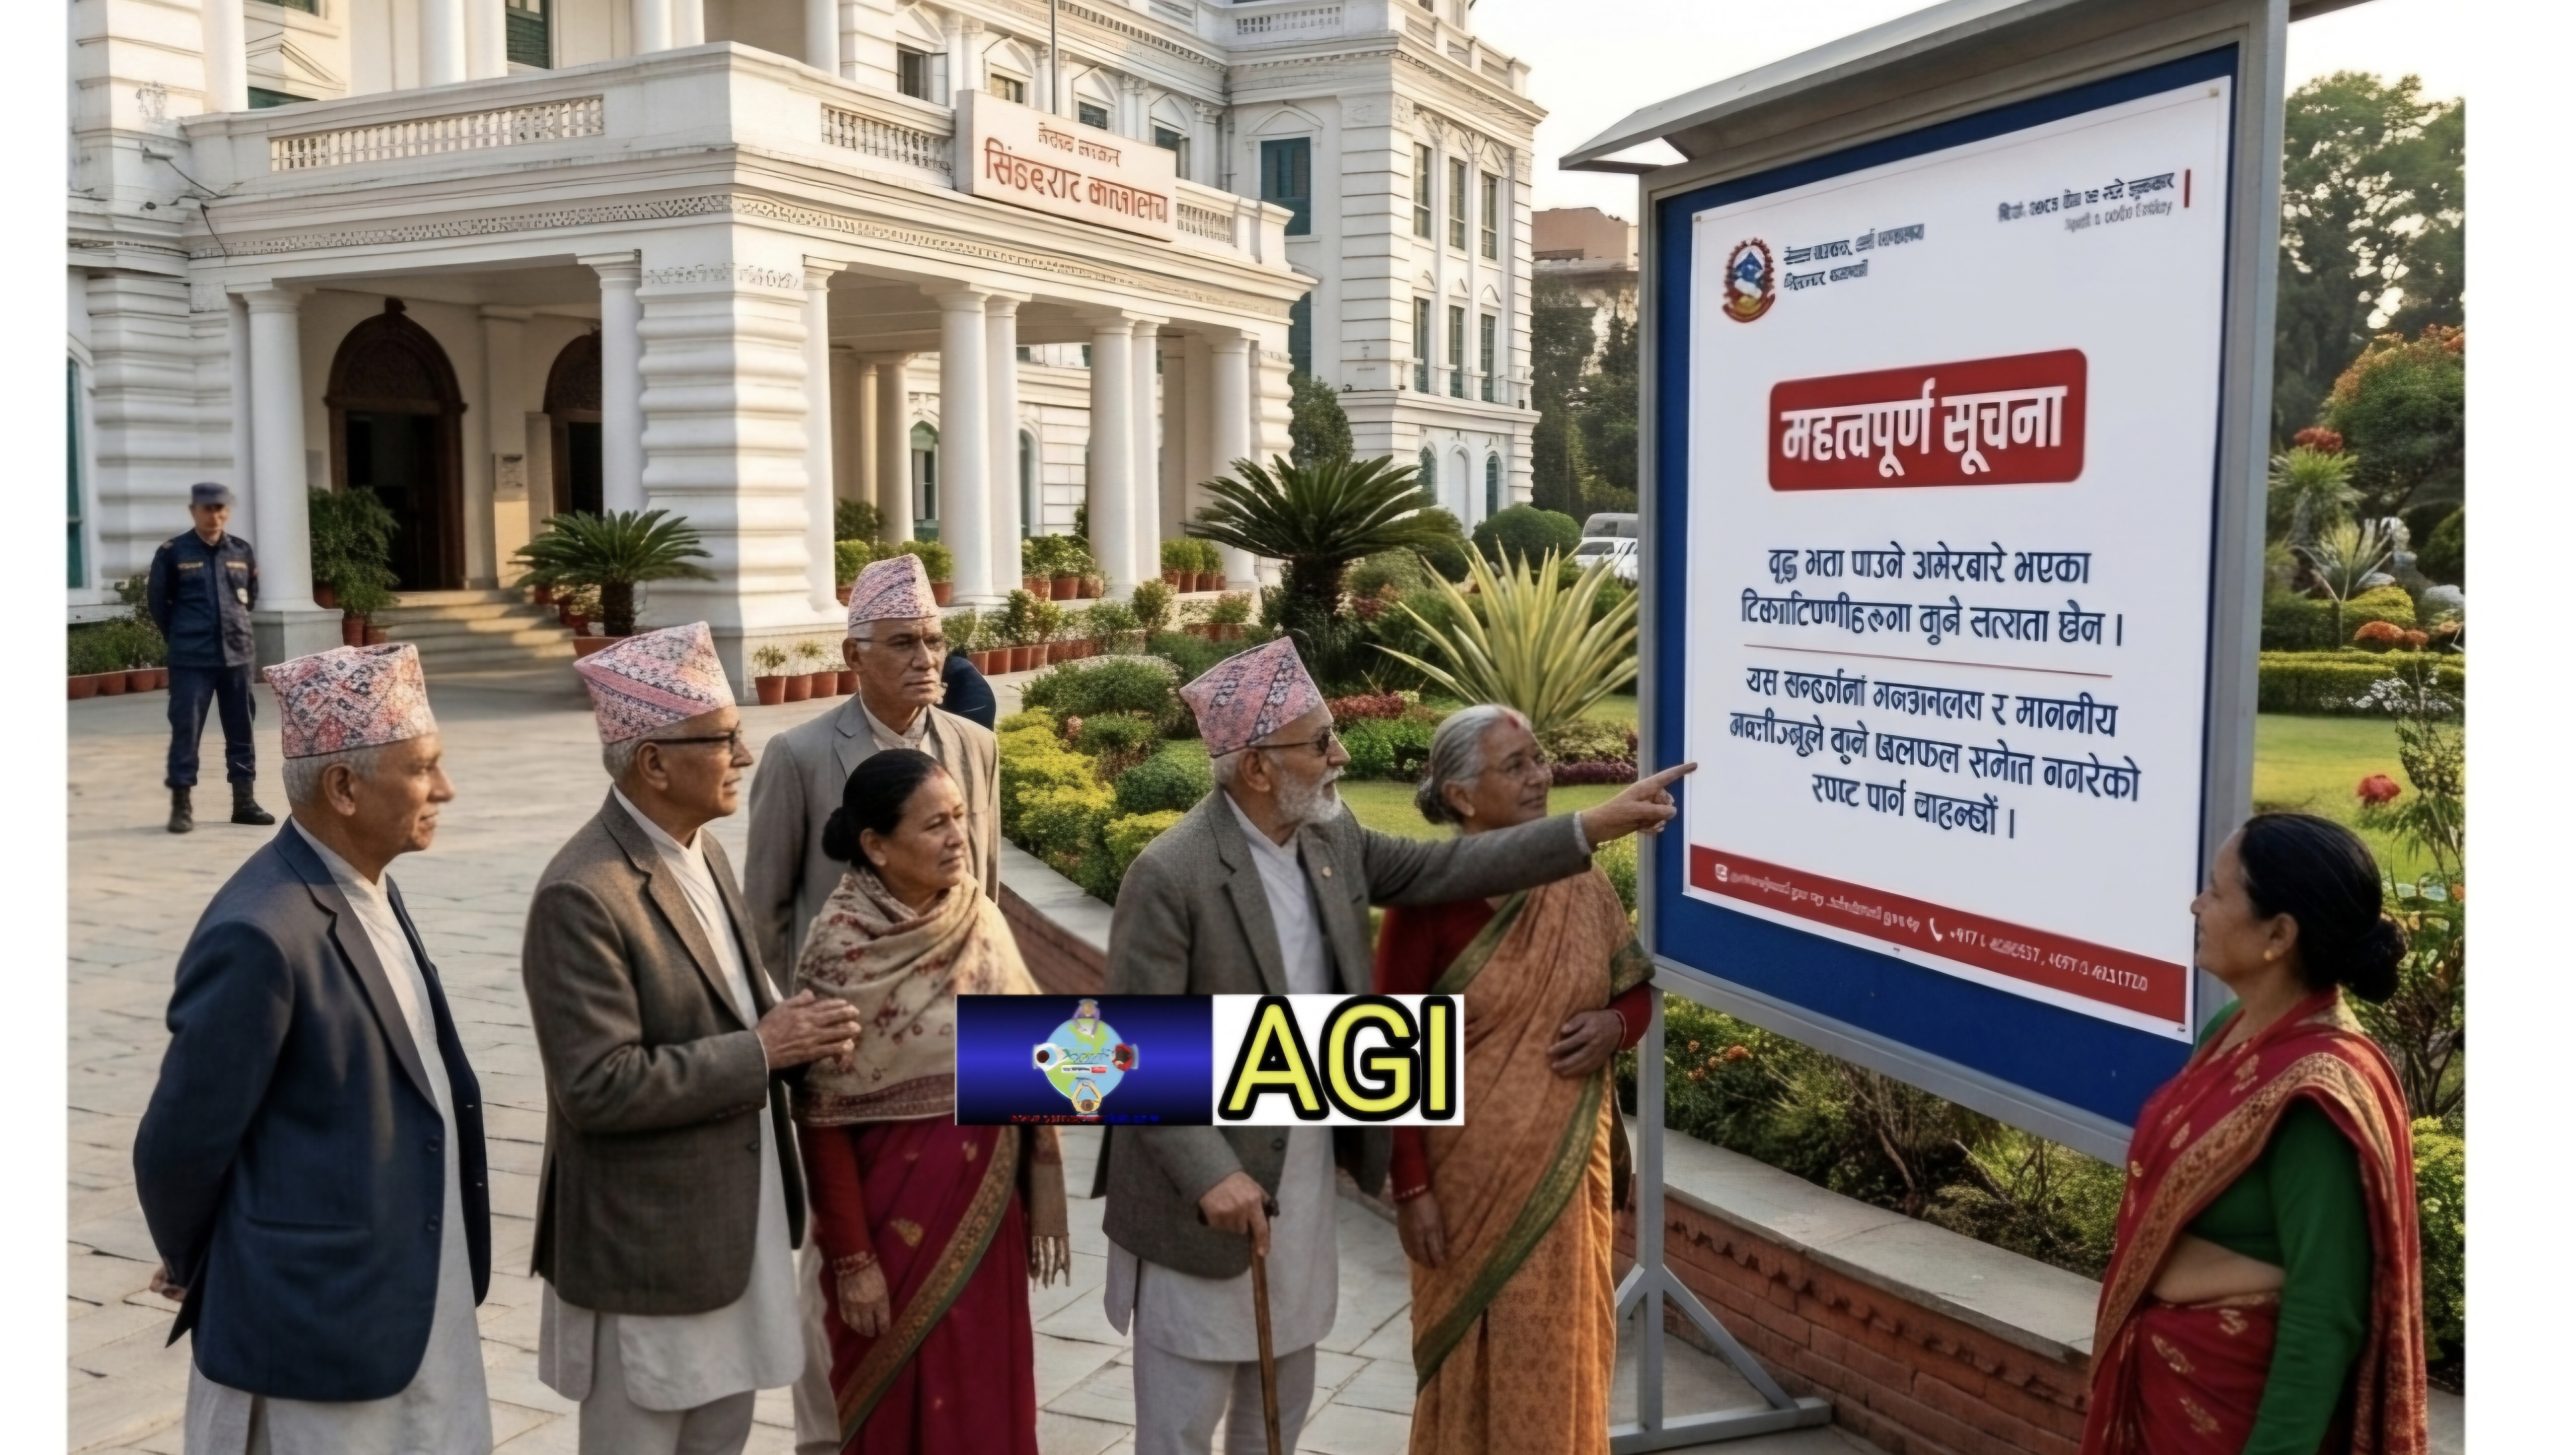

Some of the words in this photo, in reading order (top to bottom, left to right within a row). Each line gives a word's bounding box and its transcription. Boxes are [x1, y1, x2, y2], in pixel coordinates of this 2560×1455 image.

[1781, 377, 1936, 478] महत्वपूर्ण
[1941, 385, 2068, 475] सूचना
[2014, 551, 2092, 584] भएका
